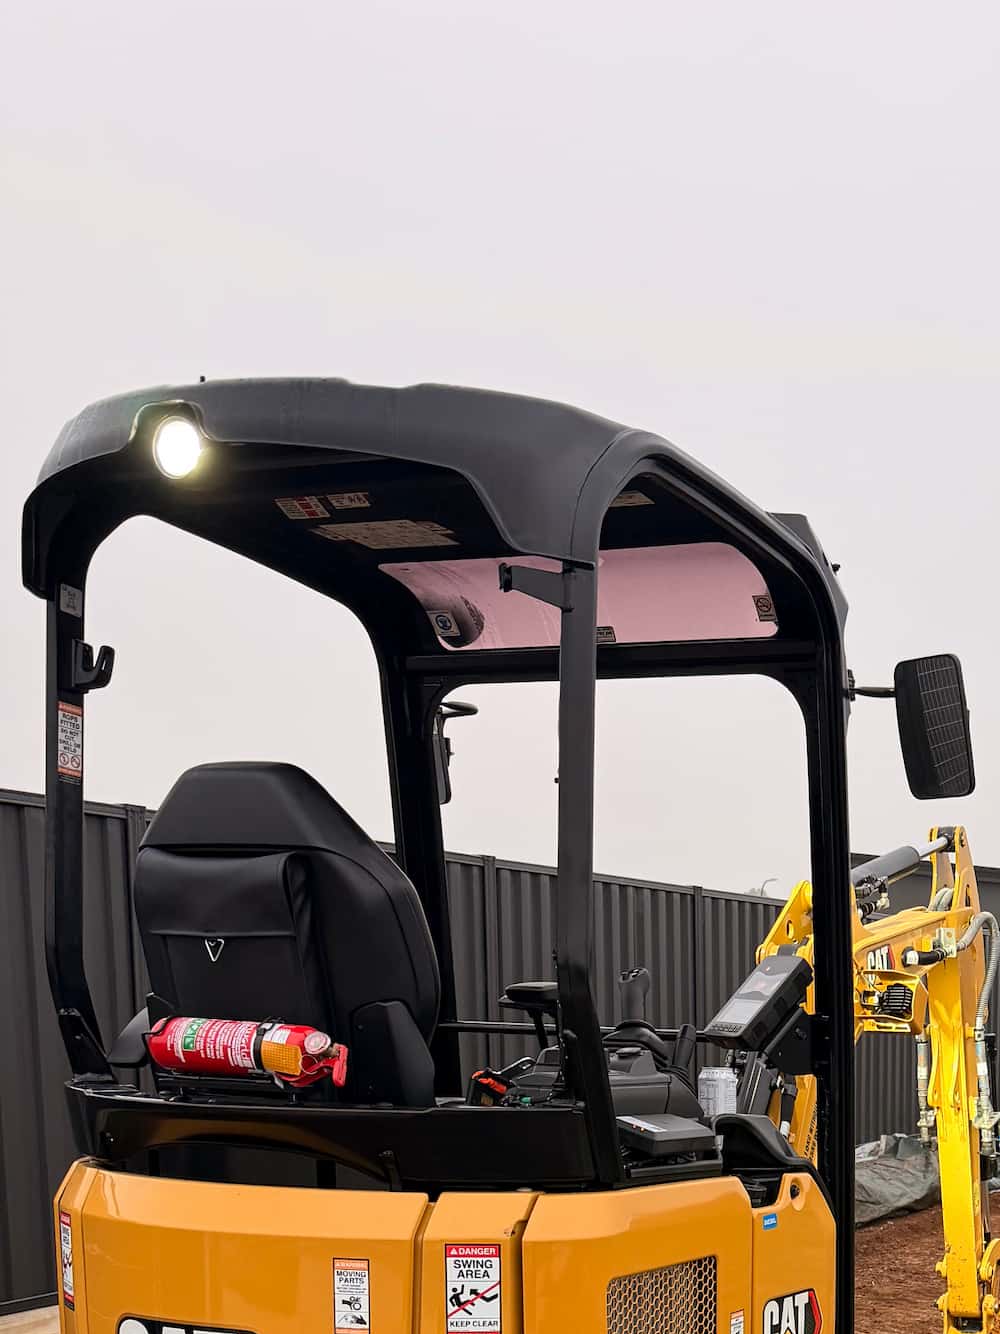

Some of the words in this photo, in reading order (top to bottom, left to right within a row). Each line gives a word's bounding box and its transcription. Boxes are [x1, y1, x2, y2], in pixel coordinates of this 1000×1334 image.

[458, 1247, 496, 1256] DANGER
[453, 1259, 493, 1269] SWING
[336, 1270, 367, 1278] MOVING
[457, 1269, 490, 1279] AREA
[338, 1277, 365, 1285] PARTS
[449, 1320, 471, 1328] KEEP
[472, 1320, 498, 1328] CLEAR
